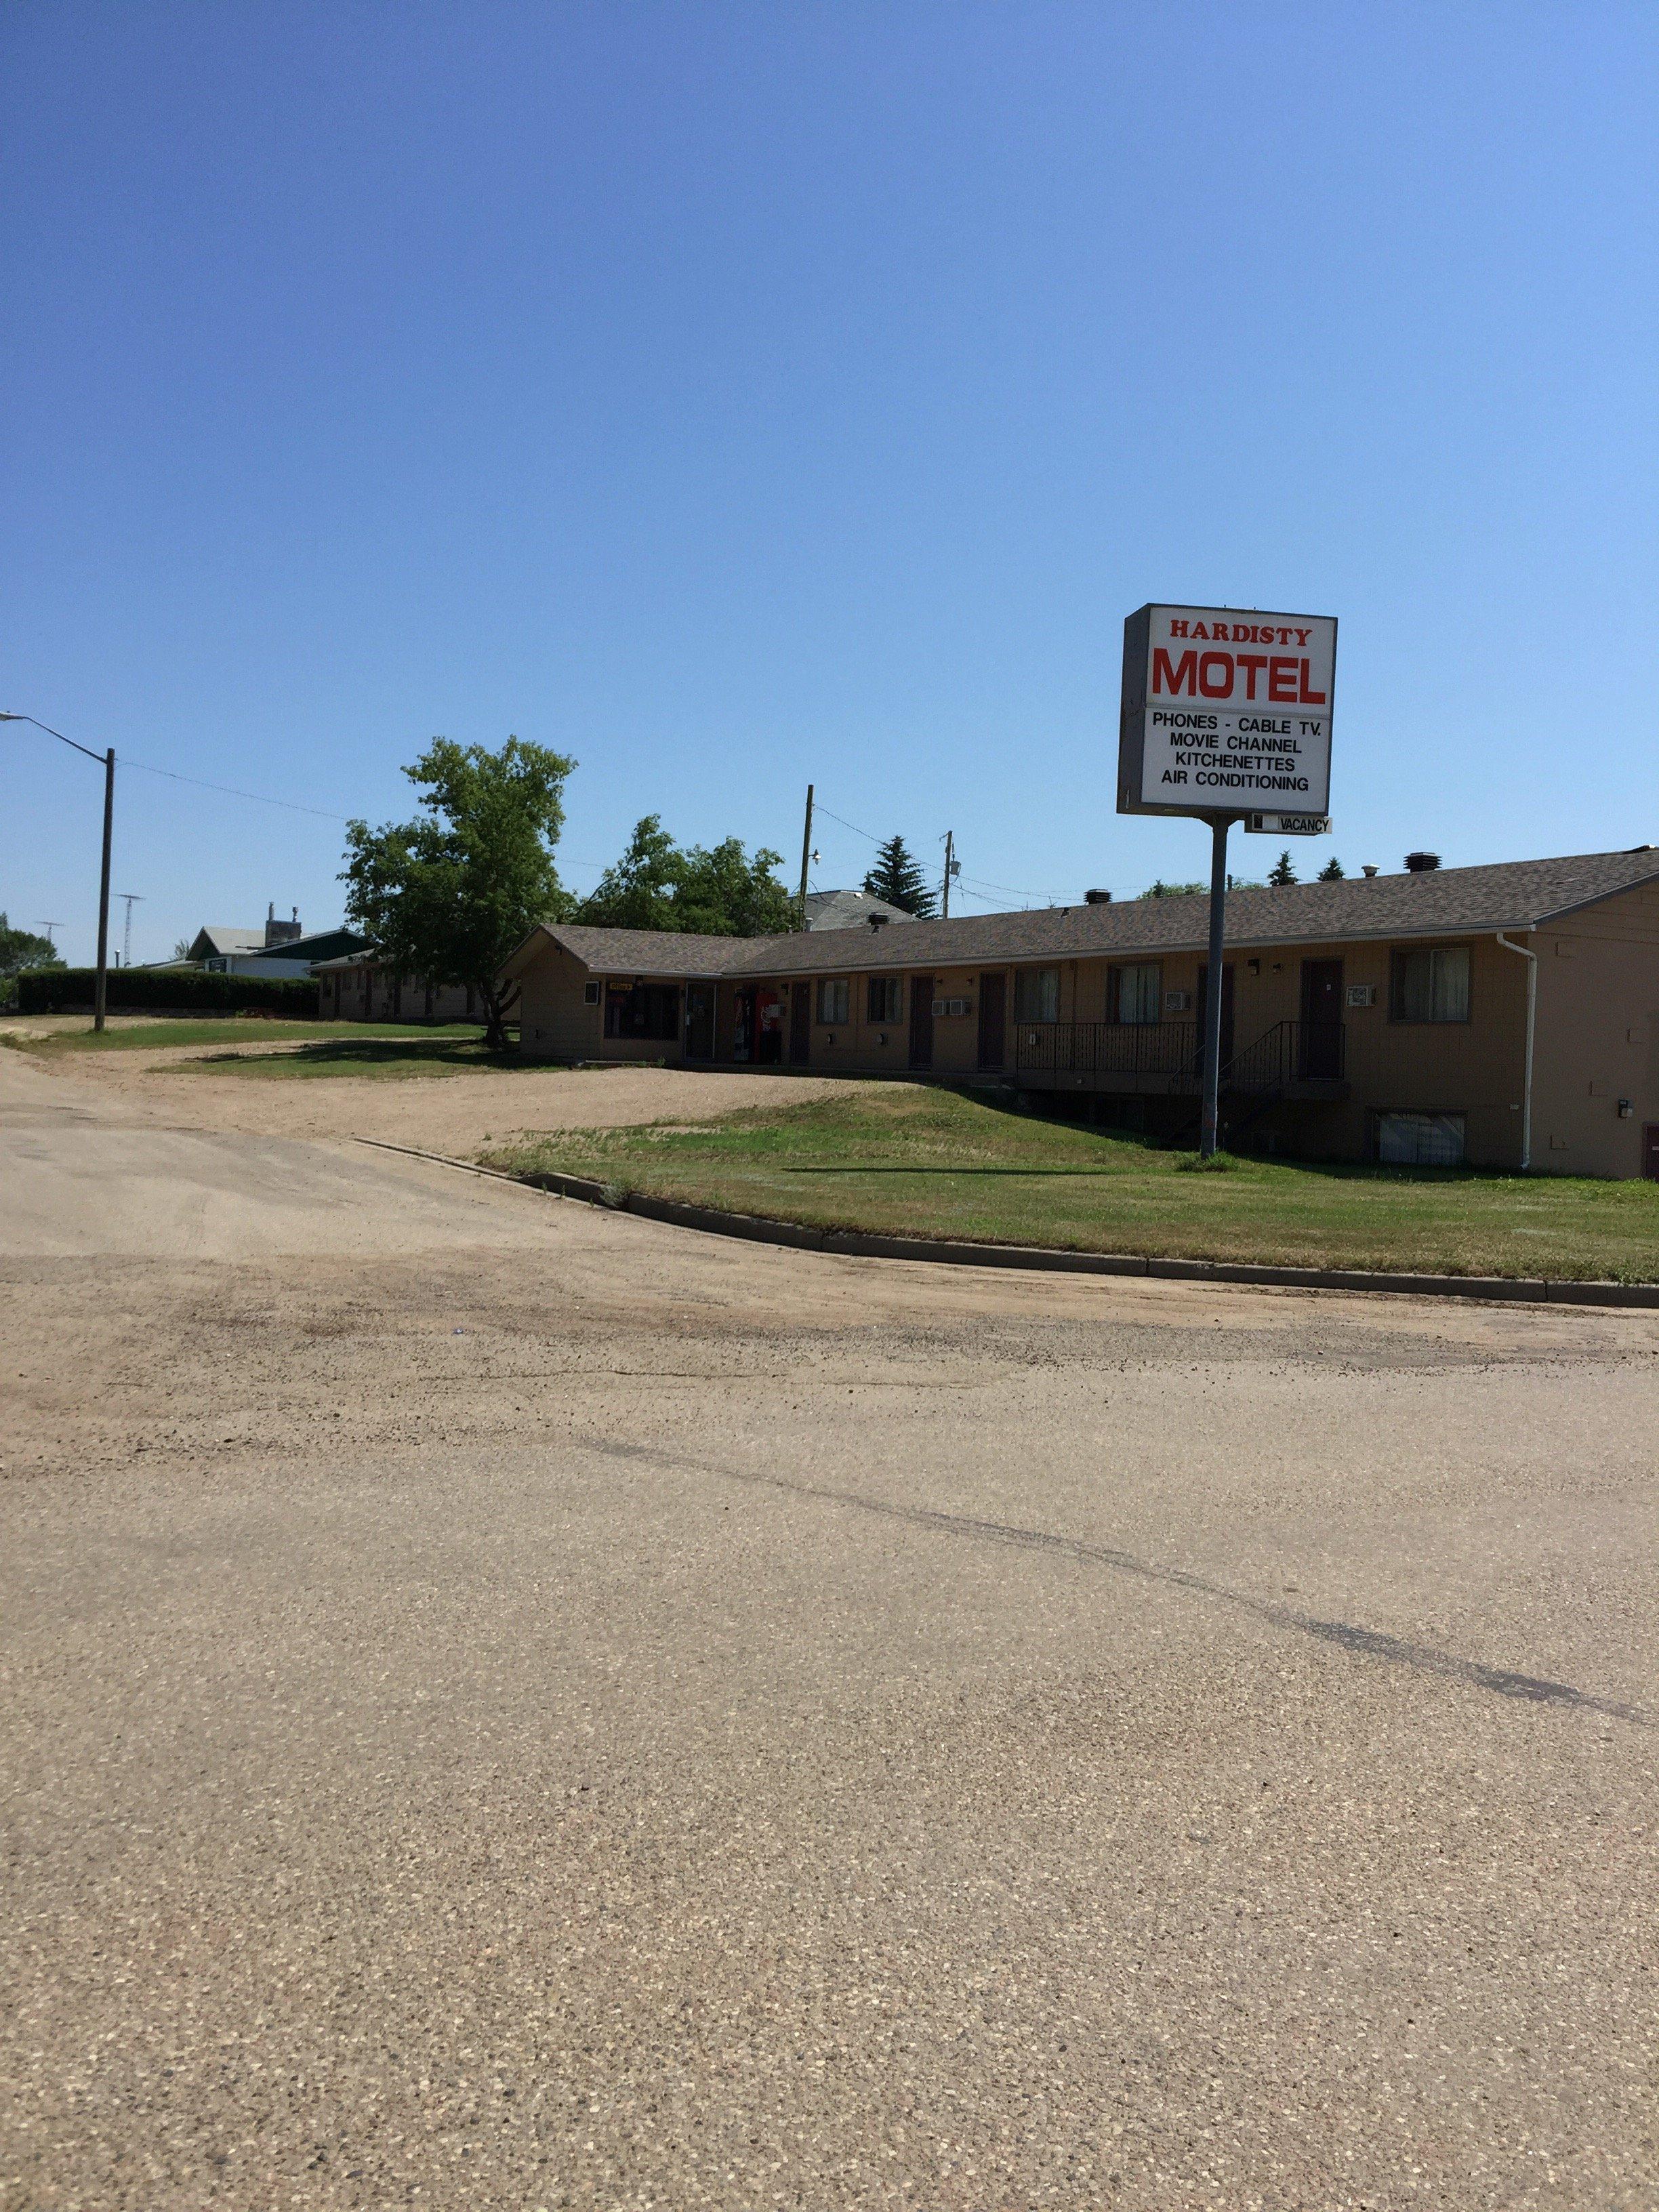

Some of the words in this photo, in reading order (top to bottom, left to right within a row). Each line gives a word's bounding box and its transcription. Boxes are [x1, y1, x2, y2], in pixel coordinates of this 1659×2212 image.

[1170, 619, 1312, 646] HARDISTY
[1153, 648, 1326, 705] MOTEL
[1153, 712, 1218, 729] PHONES
[1238, 718, 1291, 734] CABLE
[1170, 732, 1219, 748] MOVIE
[1227, 735, 1302, 753] CHANNEL
[1176, 752, 1295, 772] KITCHENETTES
[1161, 770, 1188, 784] AIR
[1195, 773, 1309, 792] CONDITIONING
[1280, 817, 1329, 832] VACANCY
